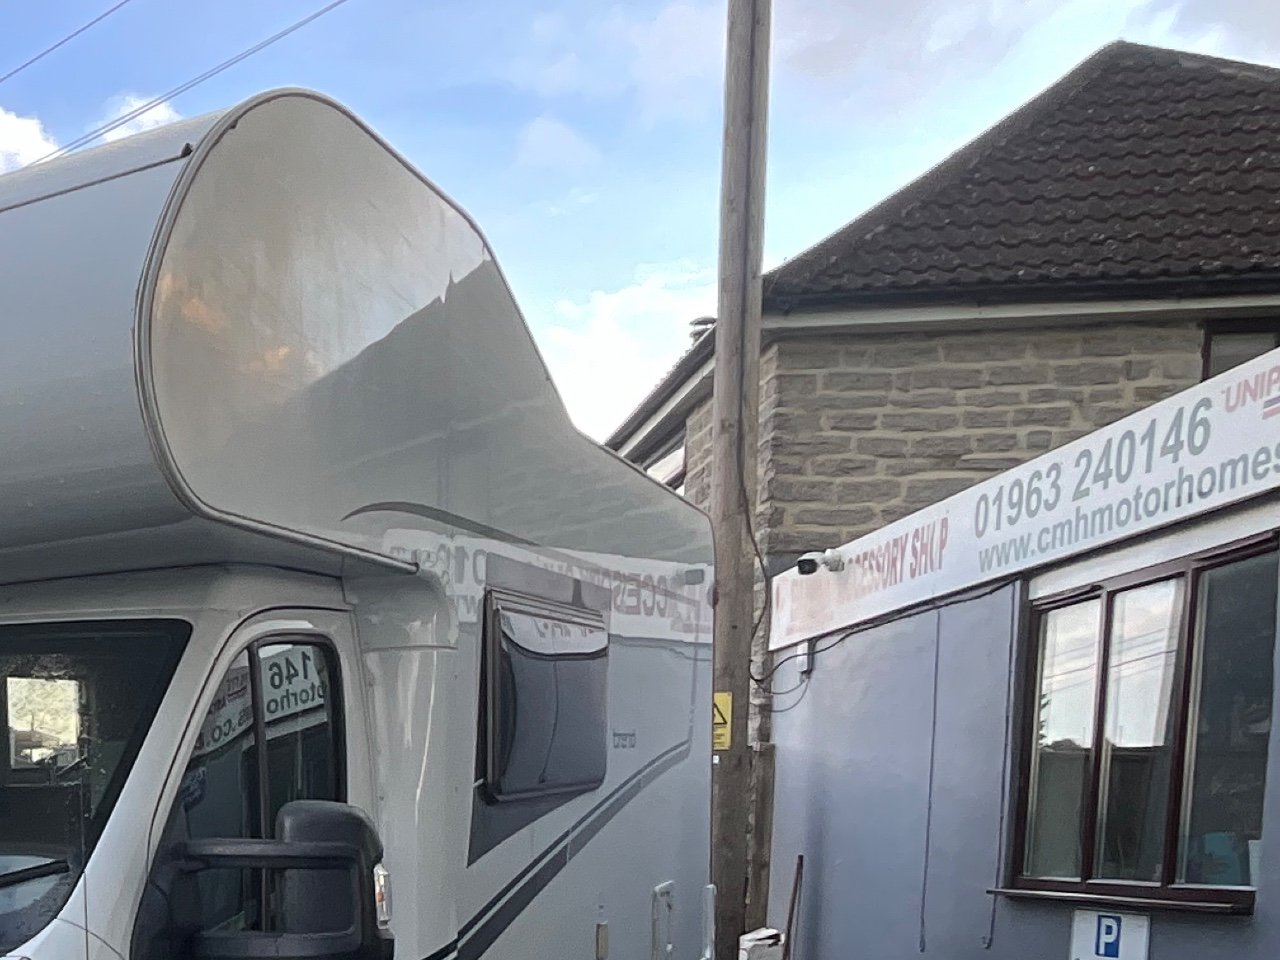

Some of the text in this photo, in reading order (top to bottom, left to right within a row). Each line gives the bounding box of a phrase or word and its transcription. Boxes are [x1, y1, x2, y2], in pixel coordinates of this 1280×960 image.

[974, 397, 1212, 538] 01963 240146
[1098, 918, 1119, 956] P
